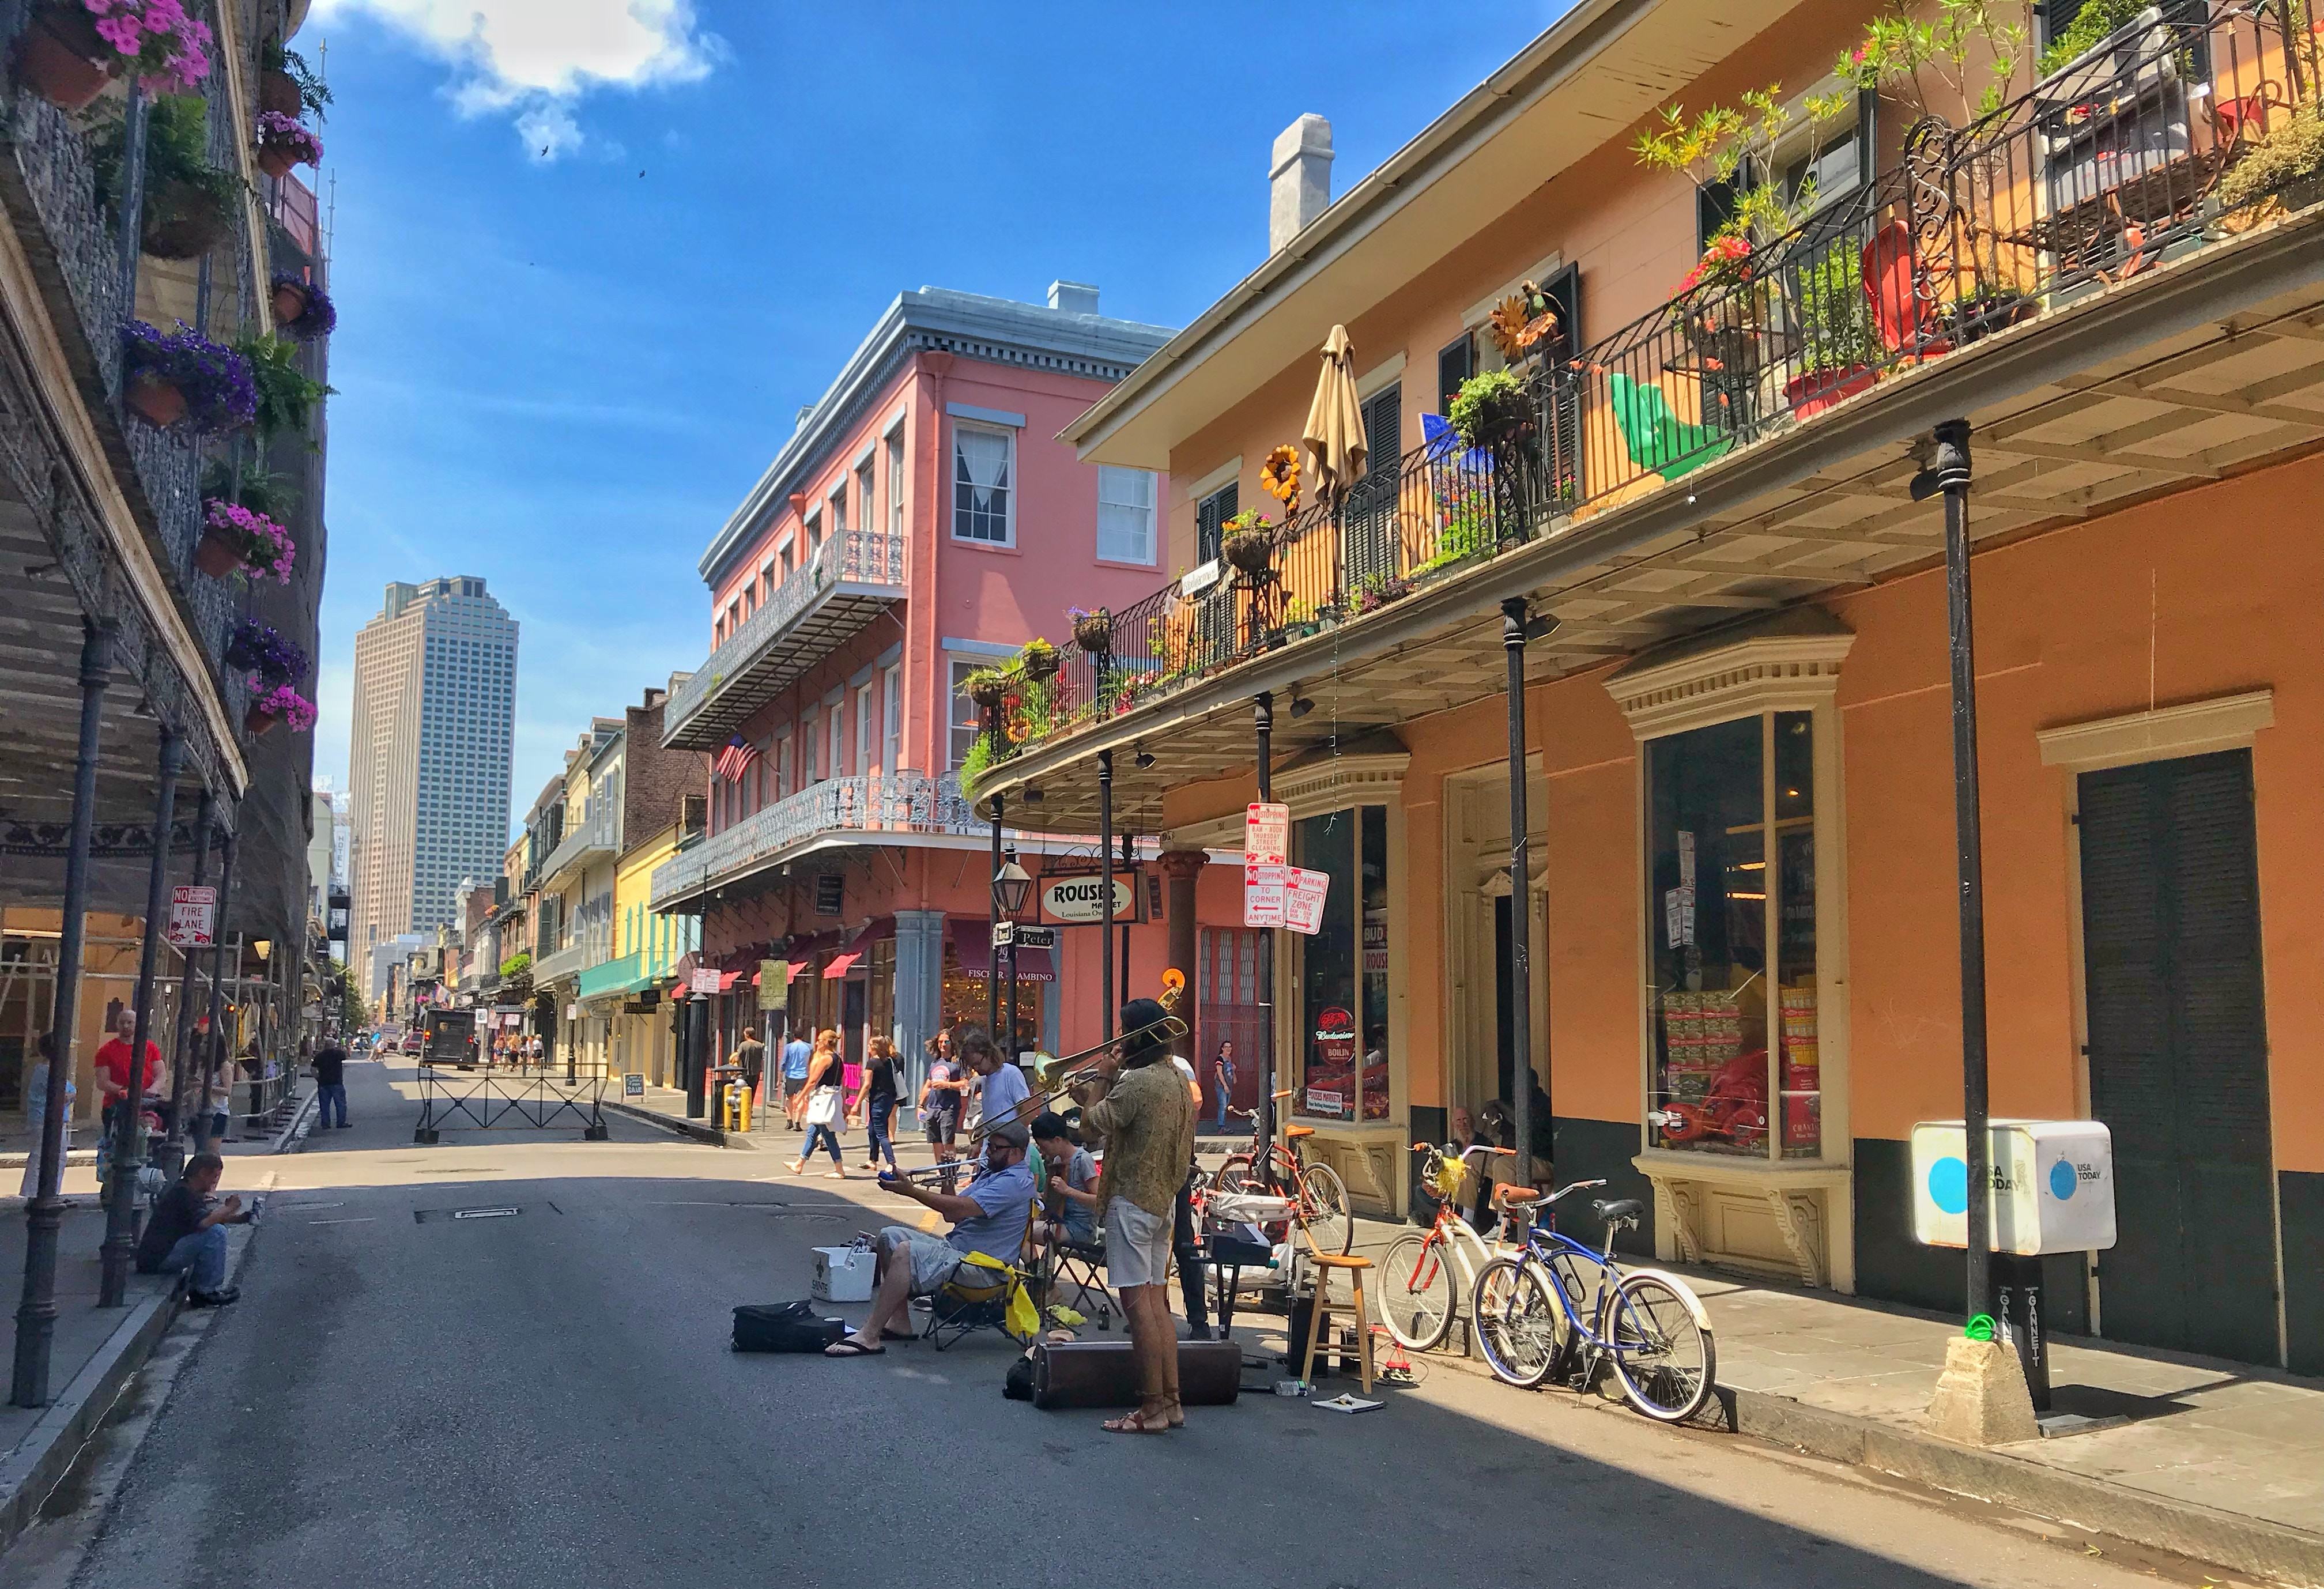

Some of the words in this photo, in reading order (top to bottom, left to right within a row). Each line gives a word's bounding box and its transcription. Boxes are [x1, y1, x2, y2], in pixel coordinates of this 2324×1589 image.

[1249, 809, 1259, 820] NO
[1260, 811, 1285, 819] STOPPING
[1247, 870, 1258, 881] NO
[1288, 872, 1299, 885] NO
[1299, 876, 1326, 889] PARKING
[175, 889, 188, 901] NO
[1288, 889, 1321, 903] FREIGHT
[1291, 900, 1314, 911] ZONE
[182, 907, 203, 916] FIRE
[1248, 914, 1281, 922] ANYTIME
[179, 919, 204, 929] LANE
[1023, 933, 1052, 944] Peter
[1364, 927, 1383, 941] BUD
[1017, 973, 1052, 981] AMBINO
[2078, 1171, 2101, 1180] TODAY
[812, 1279, 828, 1294] SAINTS
[2028, 1295, 2040, 1367] GANNETT
